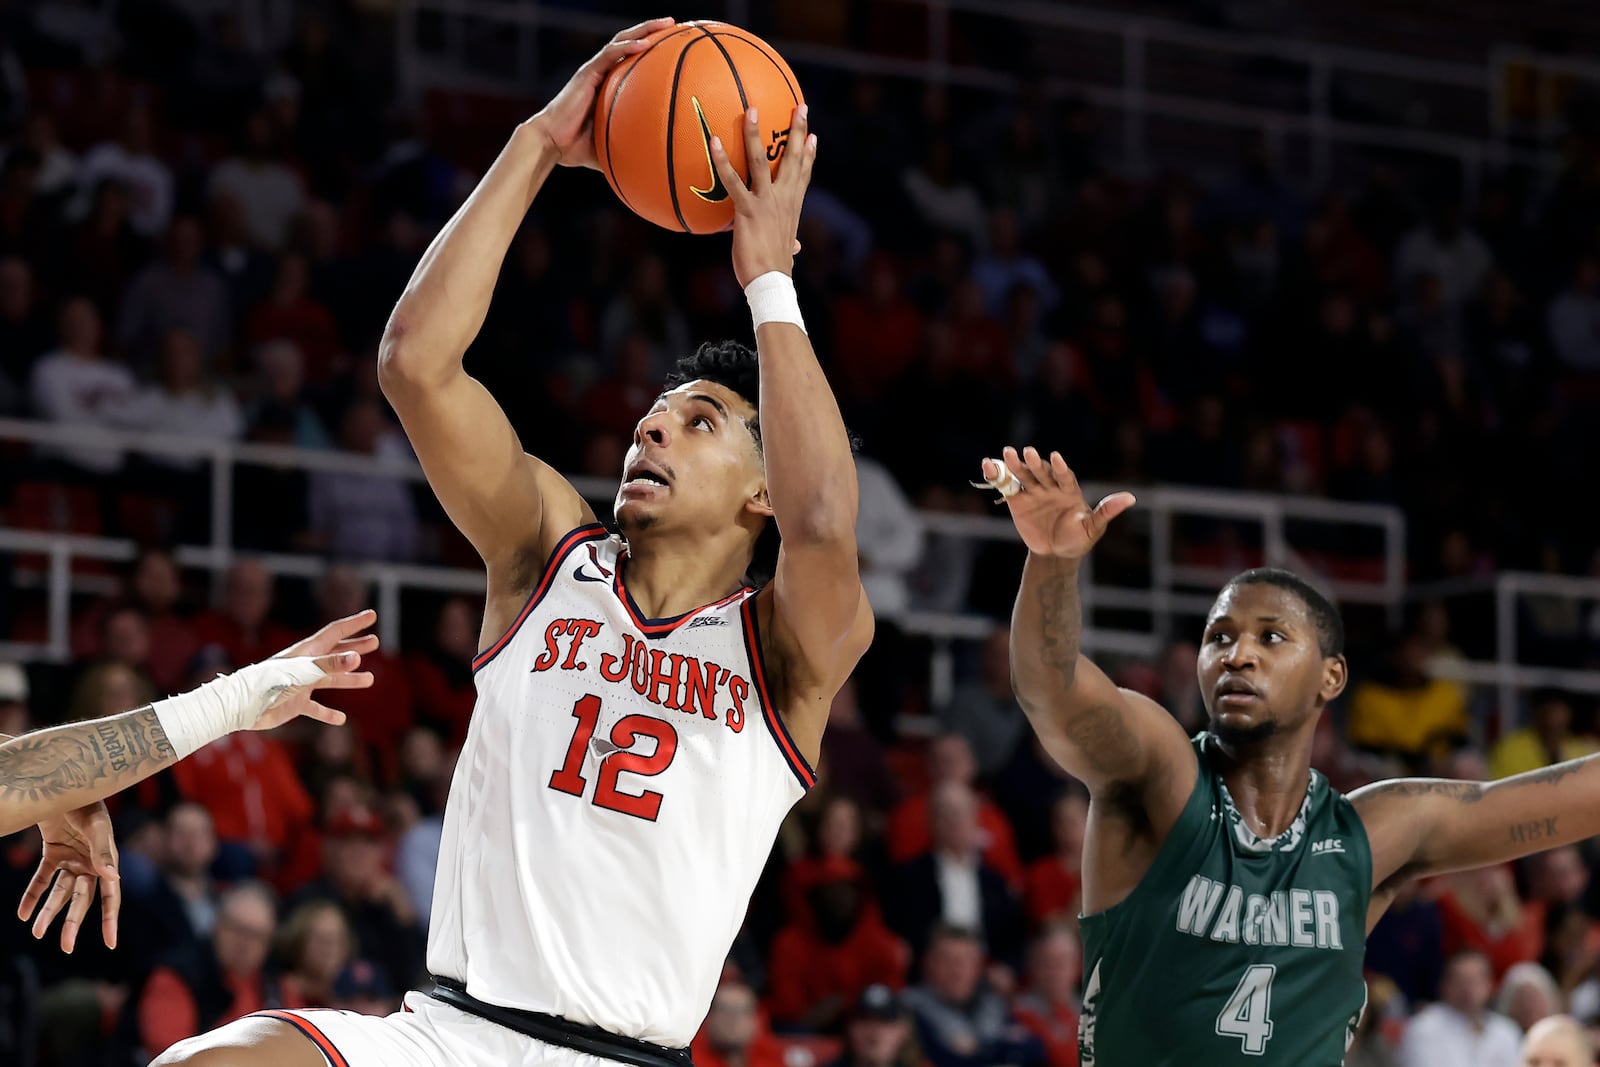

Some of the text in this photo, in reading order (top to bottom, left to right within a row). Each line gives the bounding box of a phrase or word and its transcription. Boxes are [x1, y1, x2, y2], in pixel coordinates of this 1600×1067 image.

[530, 618, 749, 734] ST. JOHN'S
[548, 693, 679, 822] 12
[1311, 838, 1342, 853] NEC
[1175, 874, 1343, 950] WAGNER
[1215, 964, 1277, 1056] 4
